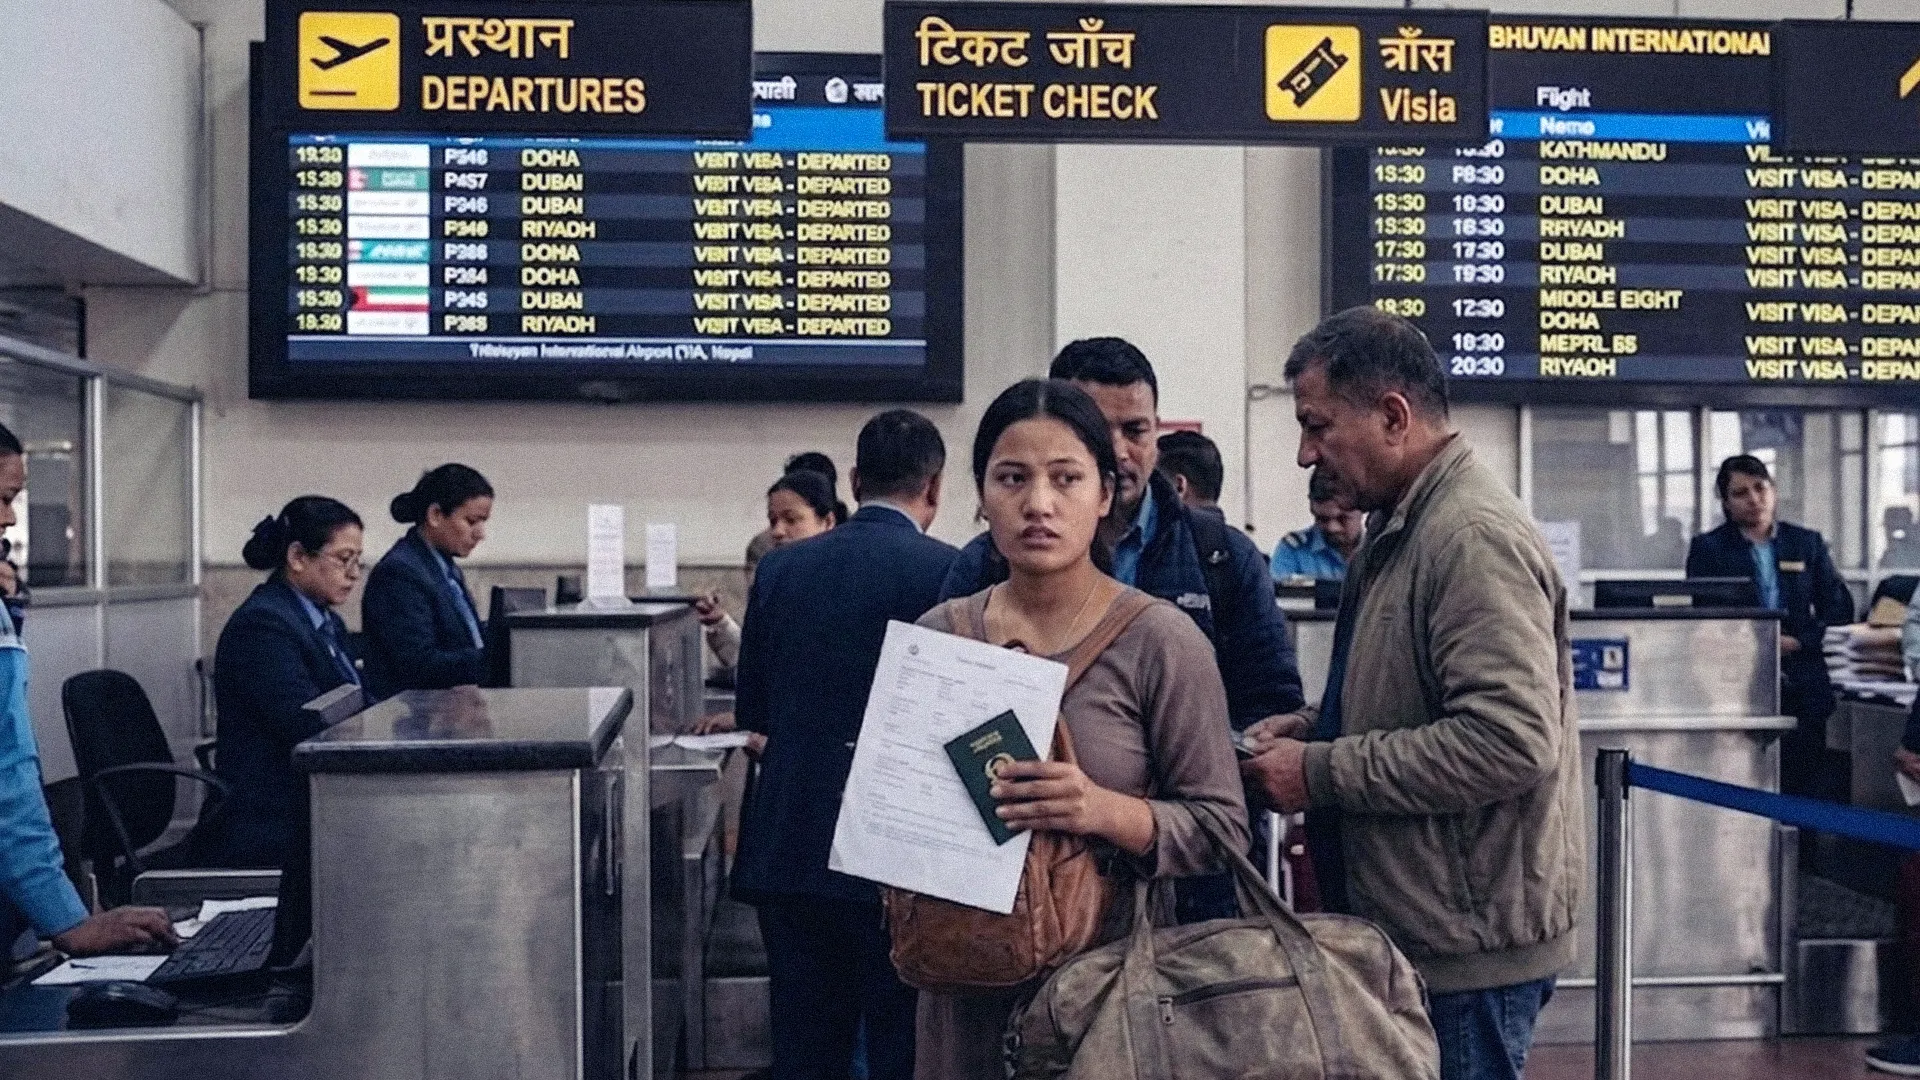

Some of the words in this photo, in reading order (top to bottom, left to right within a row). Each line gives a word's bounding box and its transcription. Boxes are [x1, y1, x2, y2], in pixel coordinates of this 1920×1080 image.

[422, 17, 574, 58] प्रस्थान
[915, 17, 1030, 66] टिकट
[1047, 18, 1135, 68] जाँच
[423, 76, 645, 113] DEPARTURES
[917, 83, 1034, 117] TICKET
[1044, 85, 1157, 118] CHECK
[1381, 88, 1455, 121] Visia
[522, 149, 580, 166] DOHA
[798, 153, 890, 170] DEPARTED
[1540, 141, 1666, 160] KATHMANDU
[522, 173, 583, 190] DUBAI
[798, 176, 890, 194] DEPARTED
[1541, 166, 1599, 185] DOHA
[1746, 169, 1797, 187] VISIT
[1801, 170, 1847, 188] VISA
[522, 197, 583, 214] DUBAI
[798, 200, 890, 218] DEPARTED
[1541, 196, 1602, 214] DUBAI
[1746, 200, 1797, 218] VISIT
[1801, 201, 1847, 219] VISA
[522, 221, 595, 238] RIYADH
[798, 224, 890, 241] DEPARTED
[1746, 223, 1797, 241] VISIT
[1801, 224, 1847, 242] VISA
[522, 244, 580, 261] DOHA
[798, 247, 890, 264] DEPARTED
[1541, 243, 1602, 260] DUBAI
[1746, 246, 1797, 264] VISIT
[1801, 247, 1847, 264] VISA
[522, 267, 579, 285] DOHA
[798, 271, 890, 288] DEPARTED
[1746, 269, 1797, 287] VISIT
[1800, 270, 1847, 288] VISA
[522, 291, 583, 309] DUBAI
[798, 294, 890, 311] DEPARTED
[522, 316, 595, 333] RIYADH
[798, 318, 890, 335] DEPARTED
[1541, 312, 1599, 329] DOHA
[1746, 303, 1797, 321] VISIT
[1801, 304, 1847, 322] VISA
[1746, 337, 1796, 354] VISIT
[1801, 337, 1847, 355] VISA
[1746, 360, 1797, 378] VISIT
[1801, 361, 1847, 379] VISA
